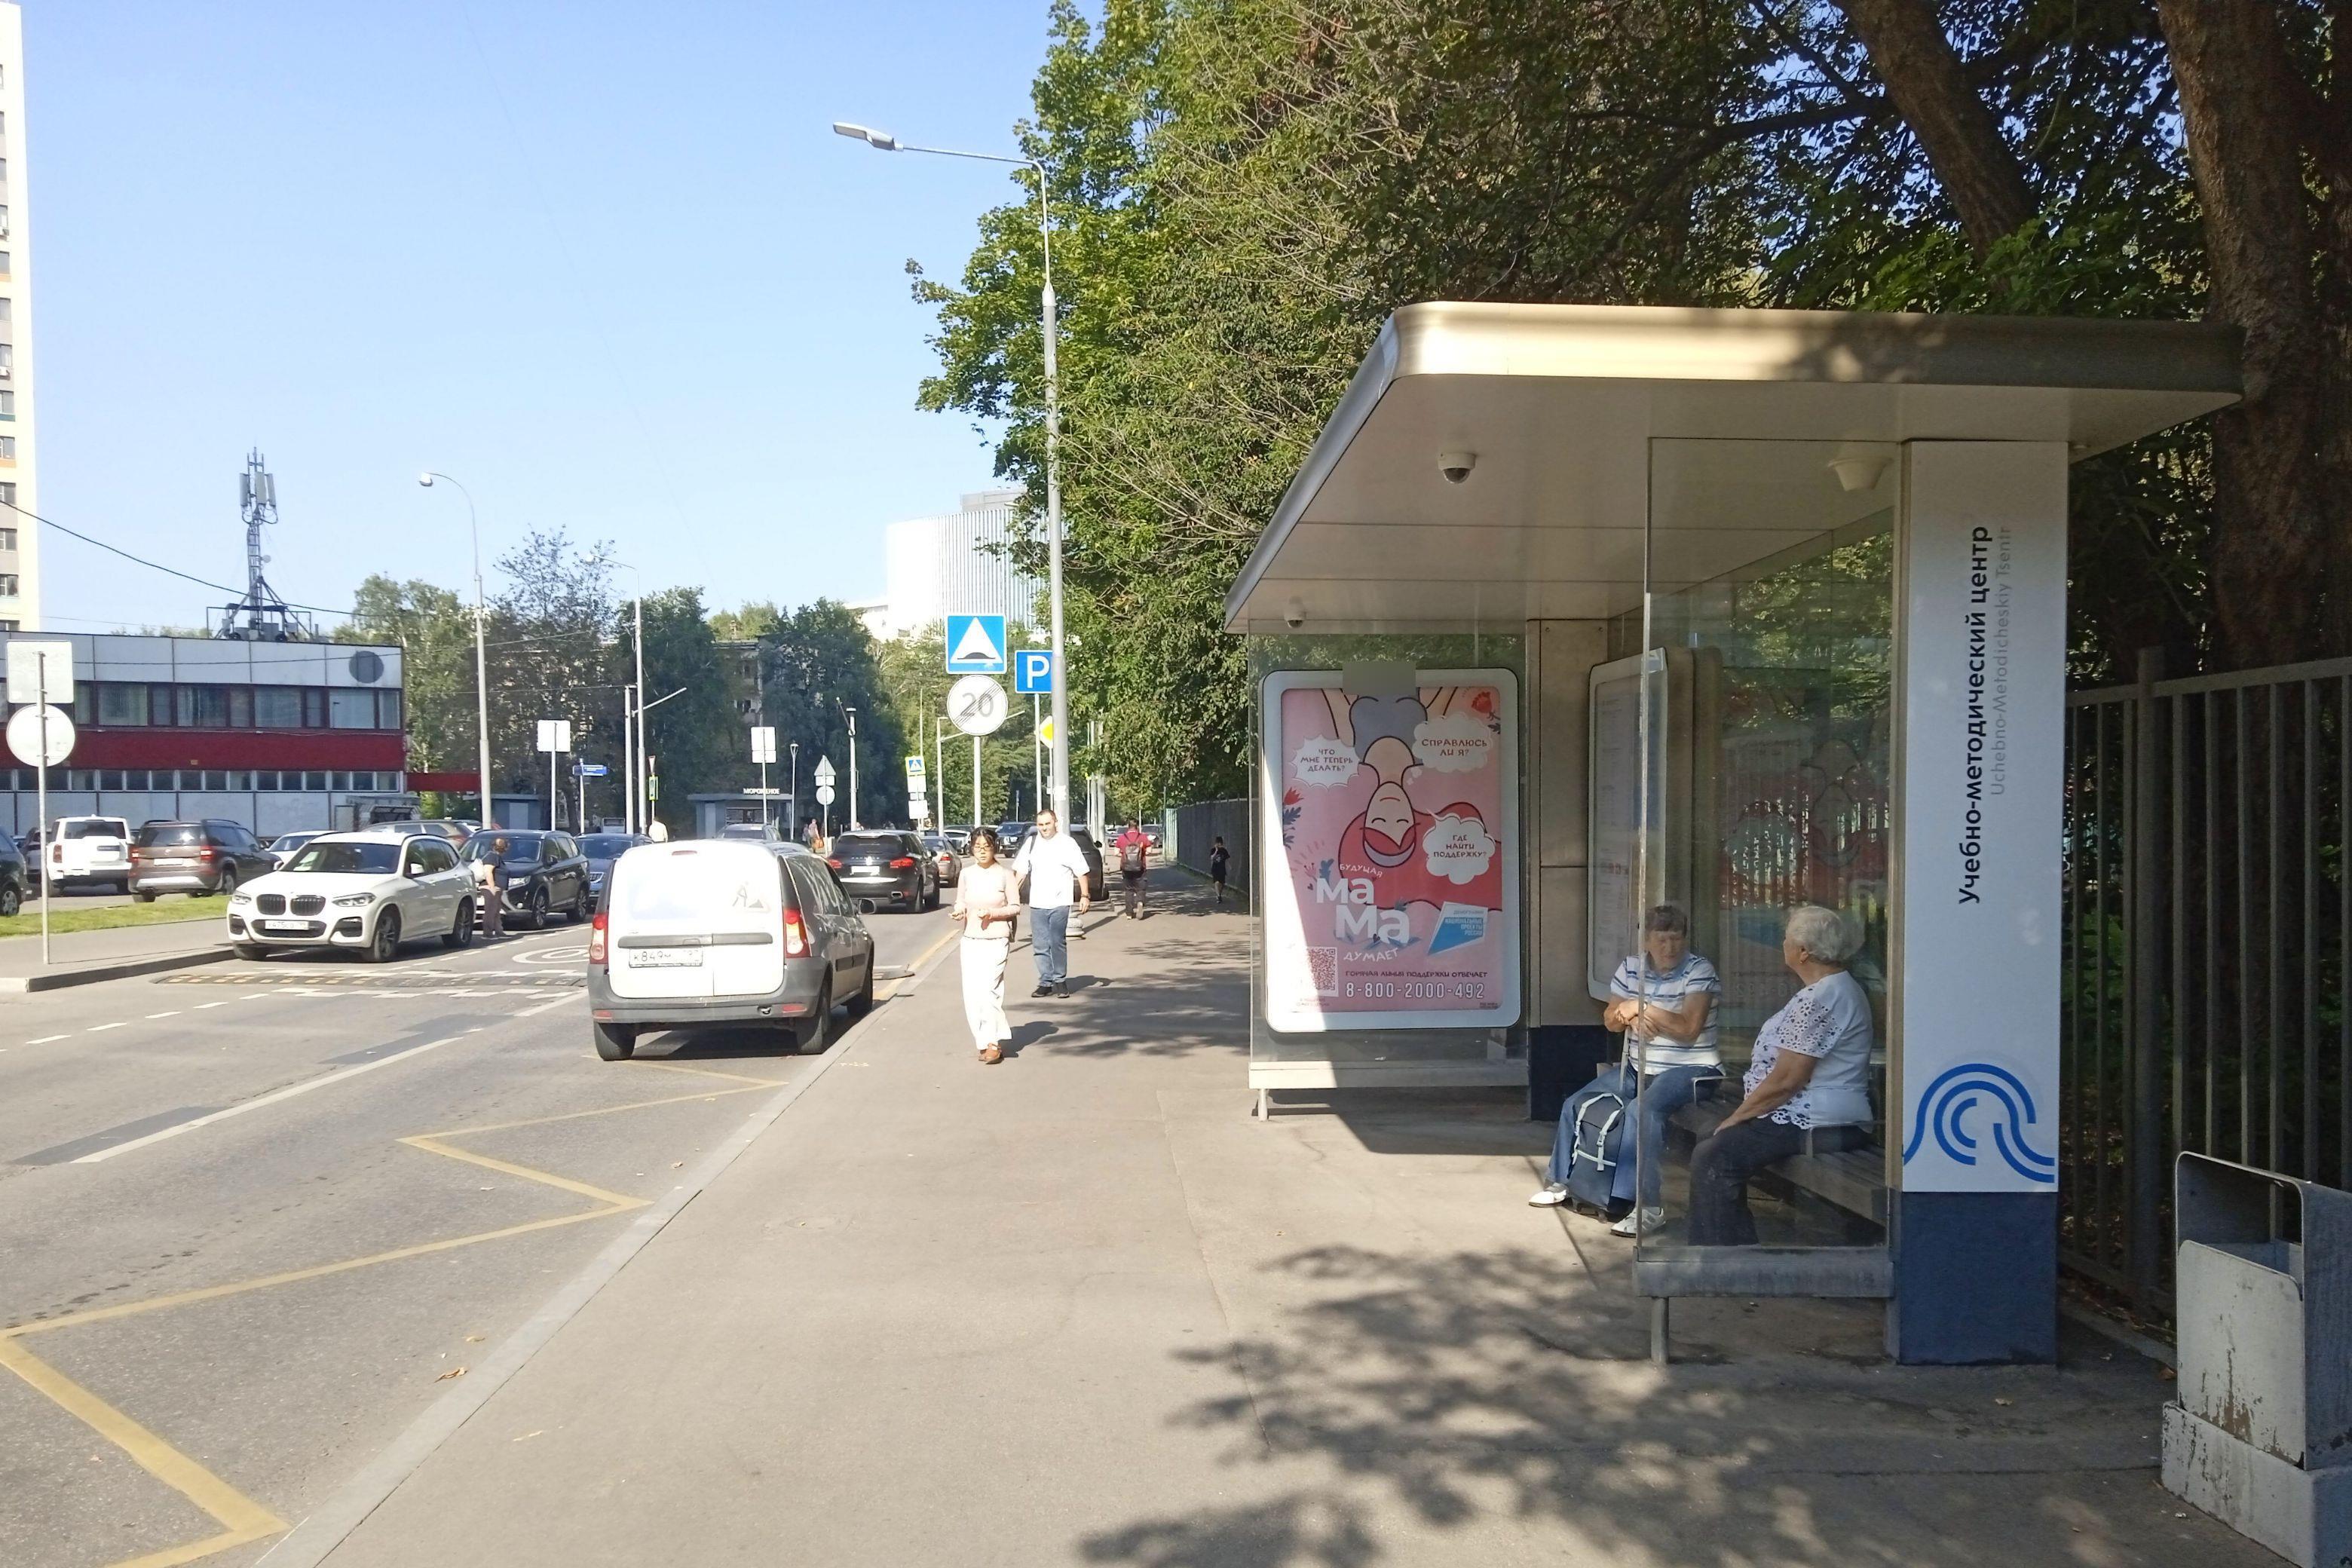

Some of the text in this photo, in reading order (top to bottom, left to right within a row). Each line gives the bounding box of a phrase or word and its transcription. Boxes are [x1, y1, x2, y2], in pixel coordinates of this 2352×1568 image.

[1991, 526, 2012, 795] Uchebno-Metodicheskiy Tsentr
[1027, 655, 1050, 689] P
[962, 692, 994, 718] 20
[1959, 526, 1992, 904] Учебно-методический центр
[1421, 738, 1487, 748] СПРАВЛЮСЬ
[1440, 749, 1470, 757] ЛИ Я?
[1307, 764, 1346, 773] ДЕЛАТЬ?
[1340, 863, 1383, 878] БУДУЩАЯ
[1343, 948, 1398, 962] ДУМАЕТ
[1346, 982, 1485, 999] 8-800-2000-492
